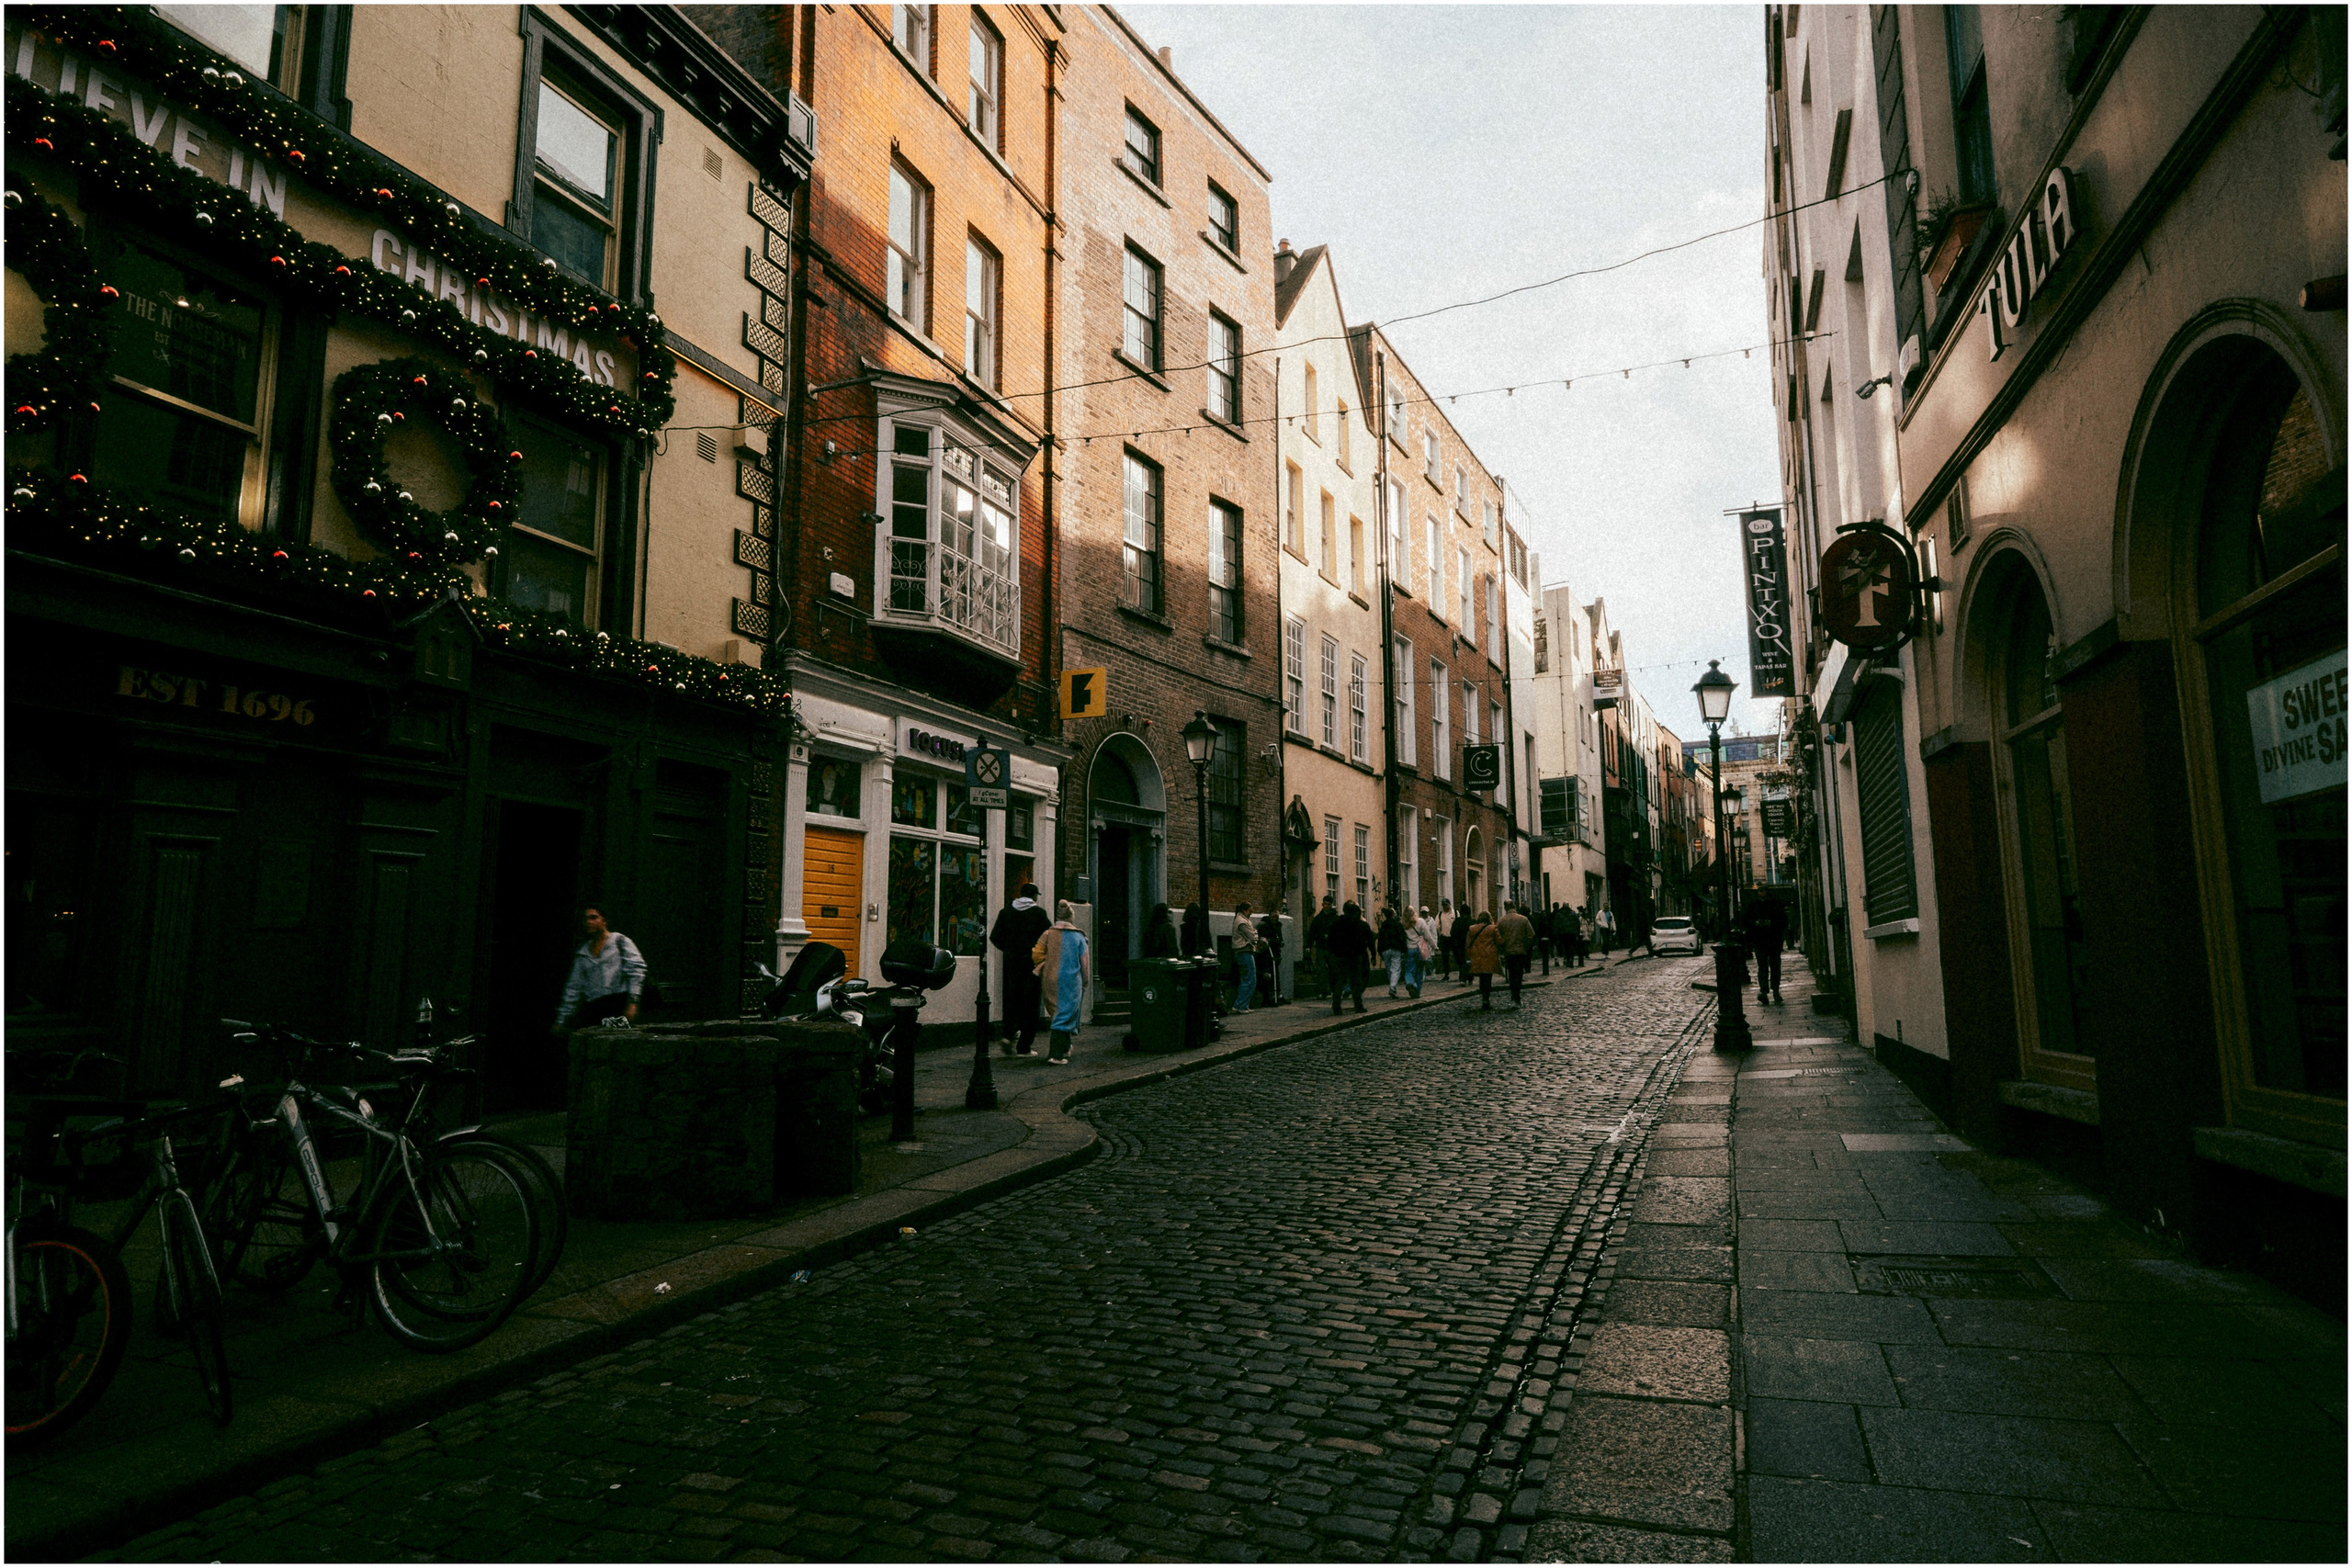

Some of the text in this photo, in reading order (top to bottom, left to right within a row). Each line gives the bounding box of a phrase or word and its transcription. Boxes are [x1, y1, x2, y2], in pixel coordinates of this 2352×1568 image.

[5, 23, 287, 221] LIEVE IN
[126, 291, 157, 321] THE
[371, 229, 615, 388] CHRISTMAS
[154, 331, 170, 345] EST
[114, 664, 315, 726] EST 1696
[2262, 735, 2316, 773] DIVINE
